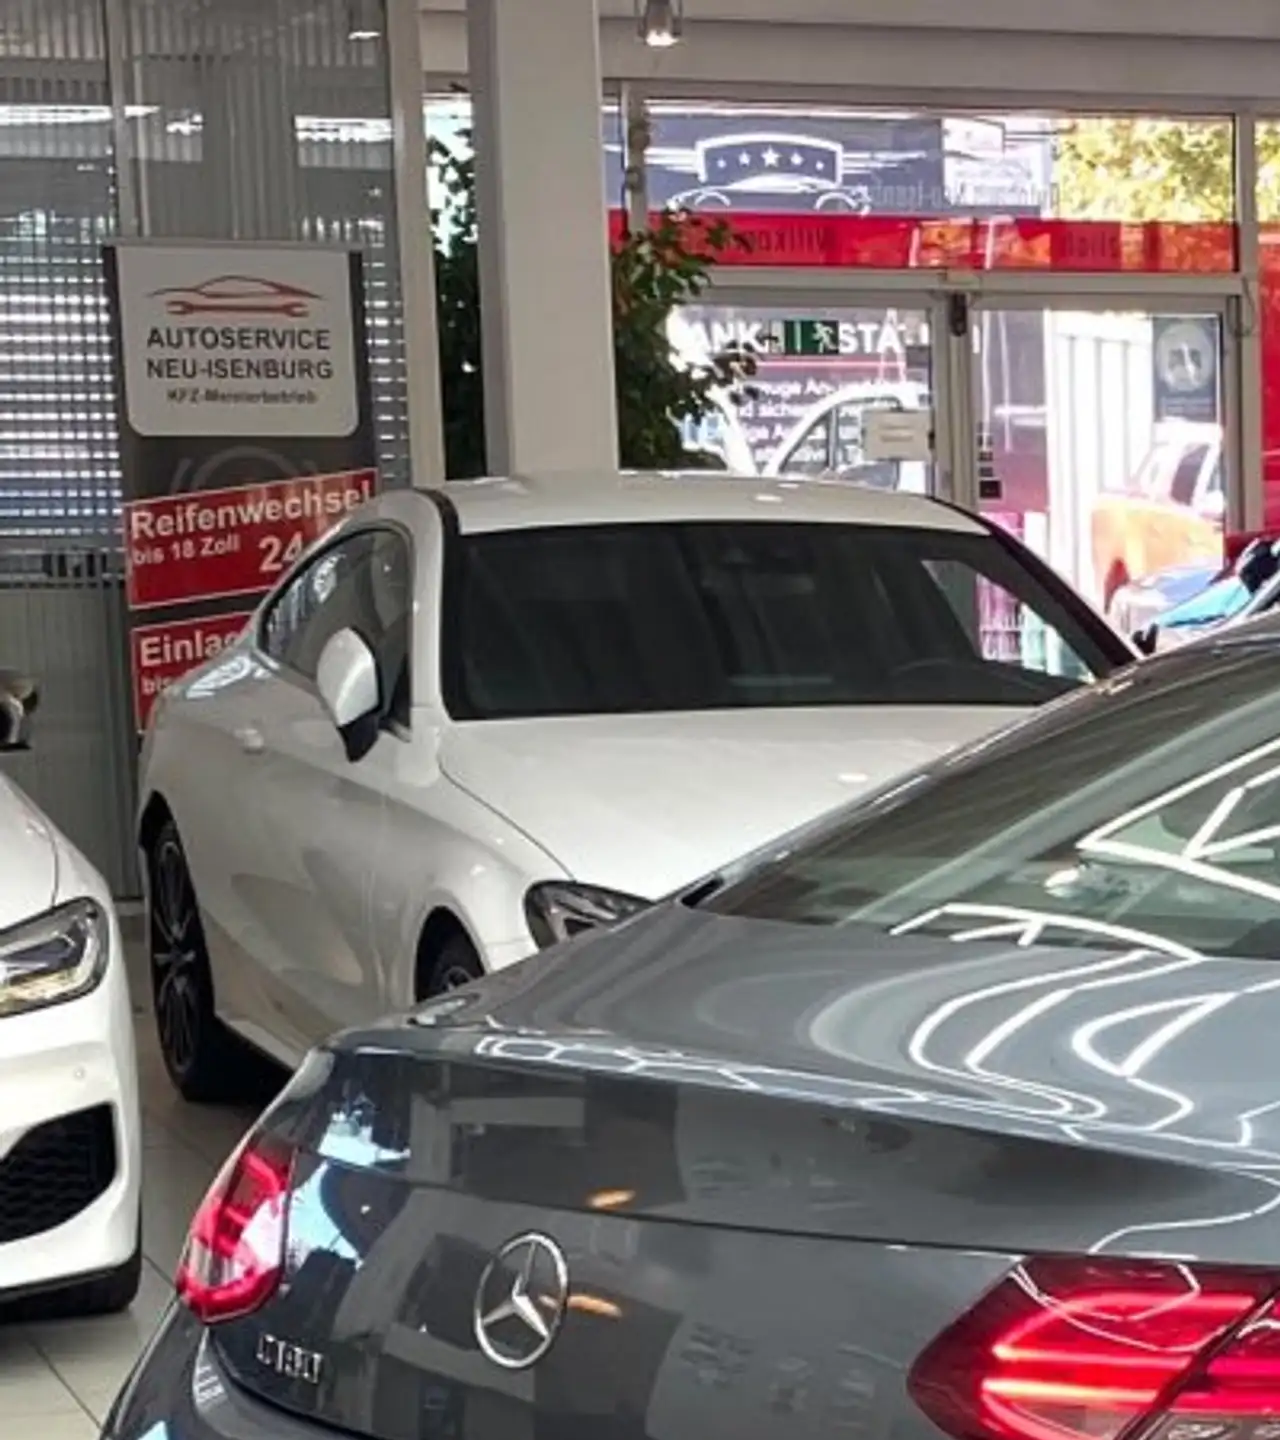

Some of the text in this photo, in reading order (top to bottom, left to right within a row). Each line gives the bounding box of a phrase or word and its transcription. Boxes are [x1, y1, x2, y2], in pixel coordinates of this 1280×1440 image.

[147, 328, 330, 351] AUTOSERVICE
[147, 359, 333, 380] NEU-ISENBURG
[131, 480, 370, 539] Reifenwechsel
[132, 545, 164, 565] bis
[172, 539, 195, 560] 18
[201, 533, 241, 556] Zoll
